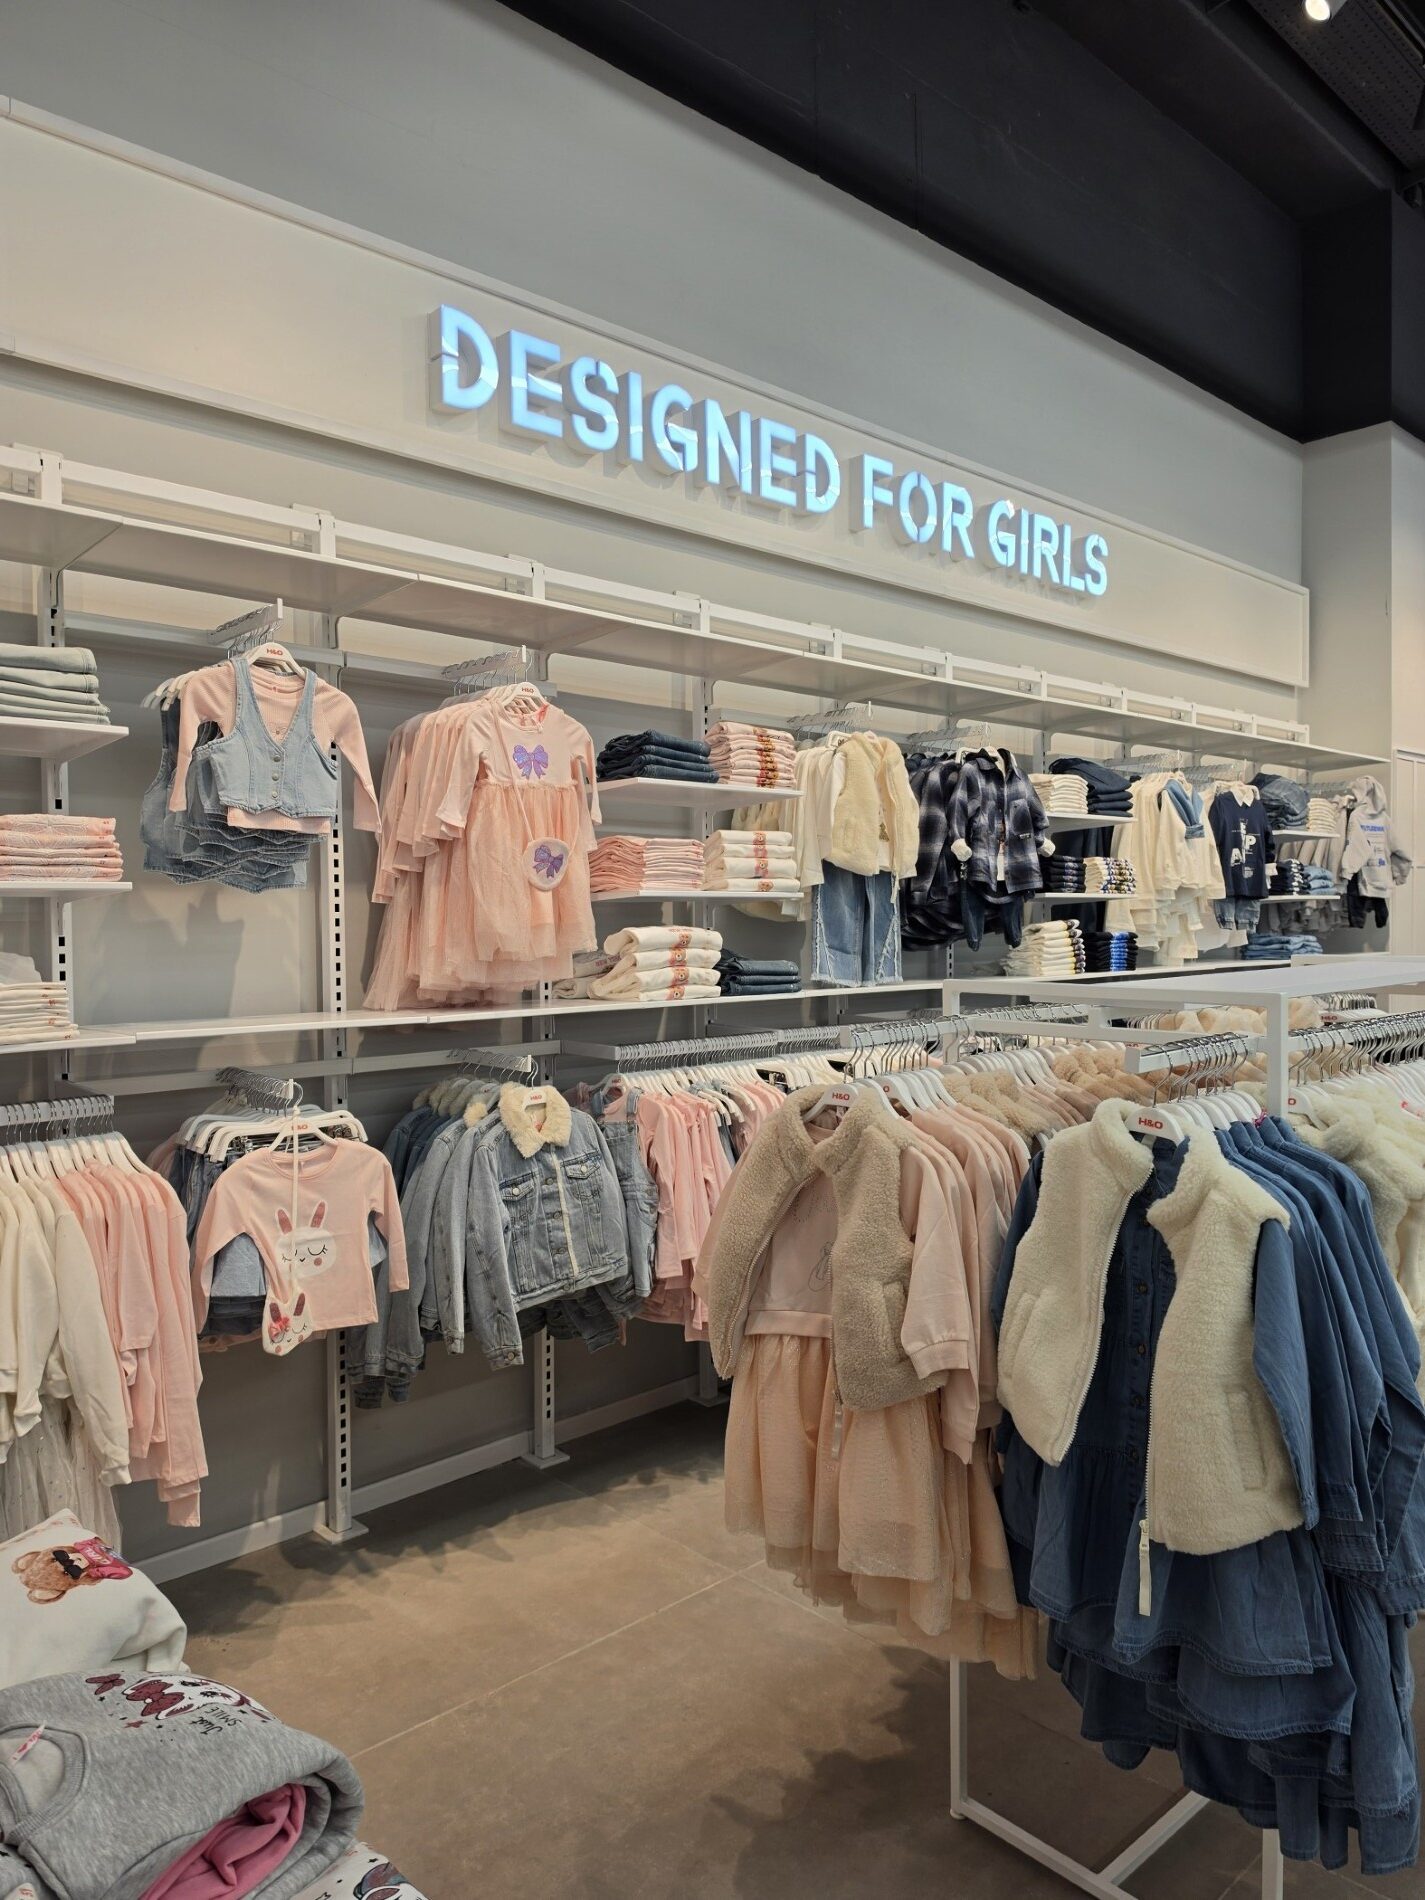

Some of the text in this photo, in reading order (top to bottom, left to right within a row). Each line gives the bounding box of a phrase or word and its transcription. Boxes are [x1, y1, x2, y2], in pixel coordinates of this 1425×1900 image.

[438, 303, 1110, 597] DESIGNED FOR GIRLS
[832, 1092, 850, 1100] H&O
[1138, 1117, 1164, 1129] H&O
